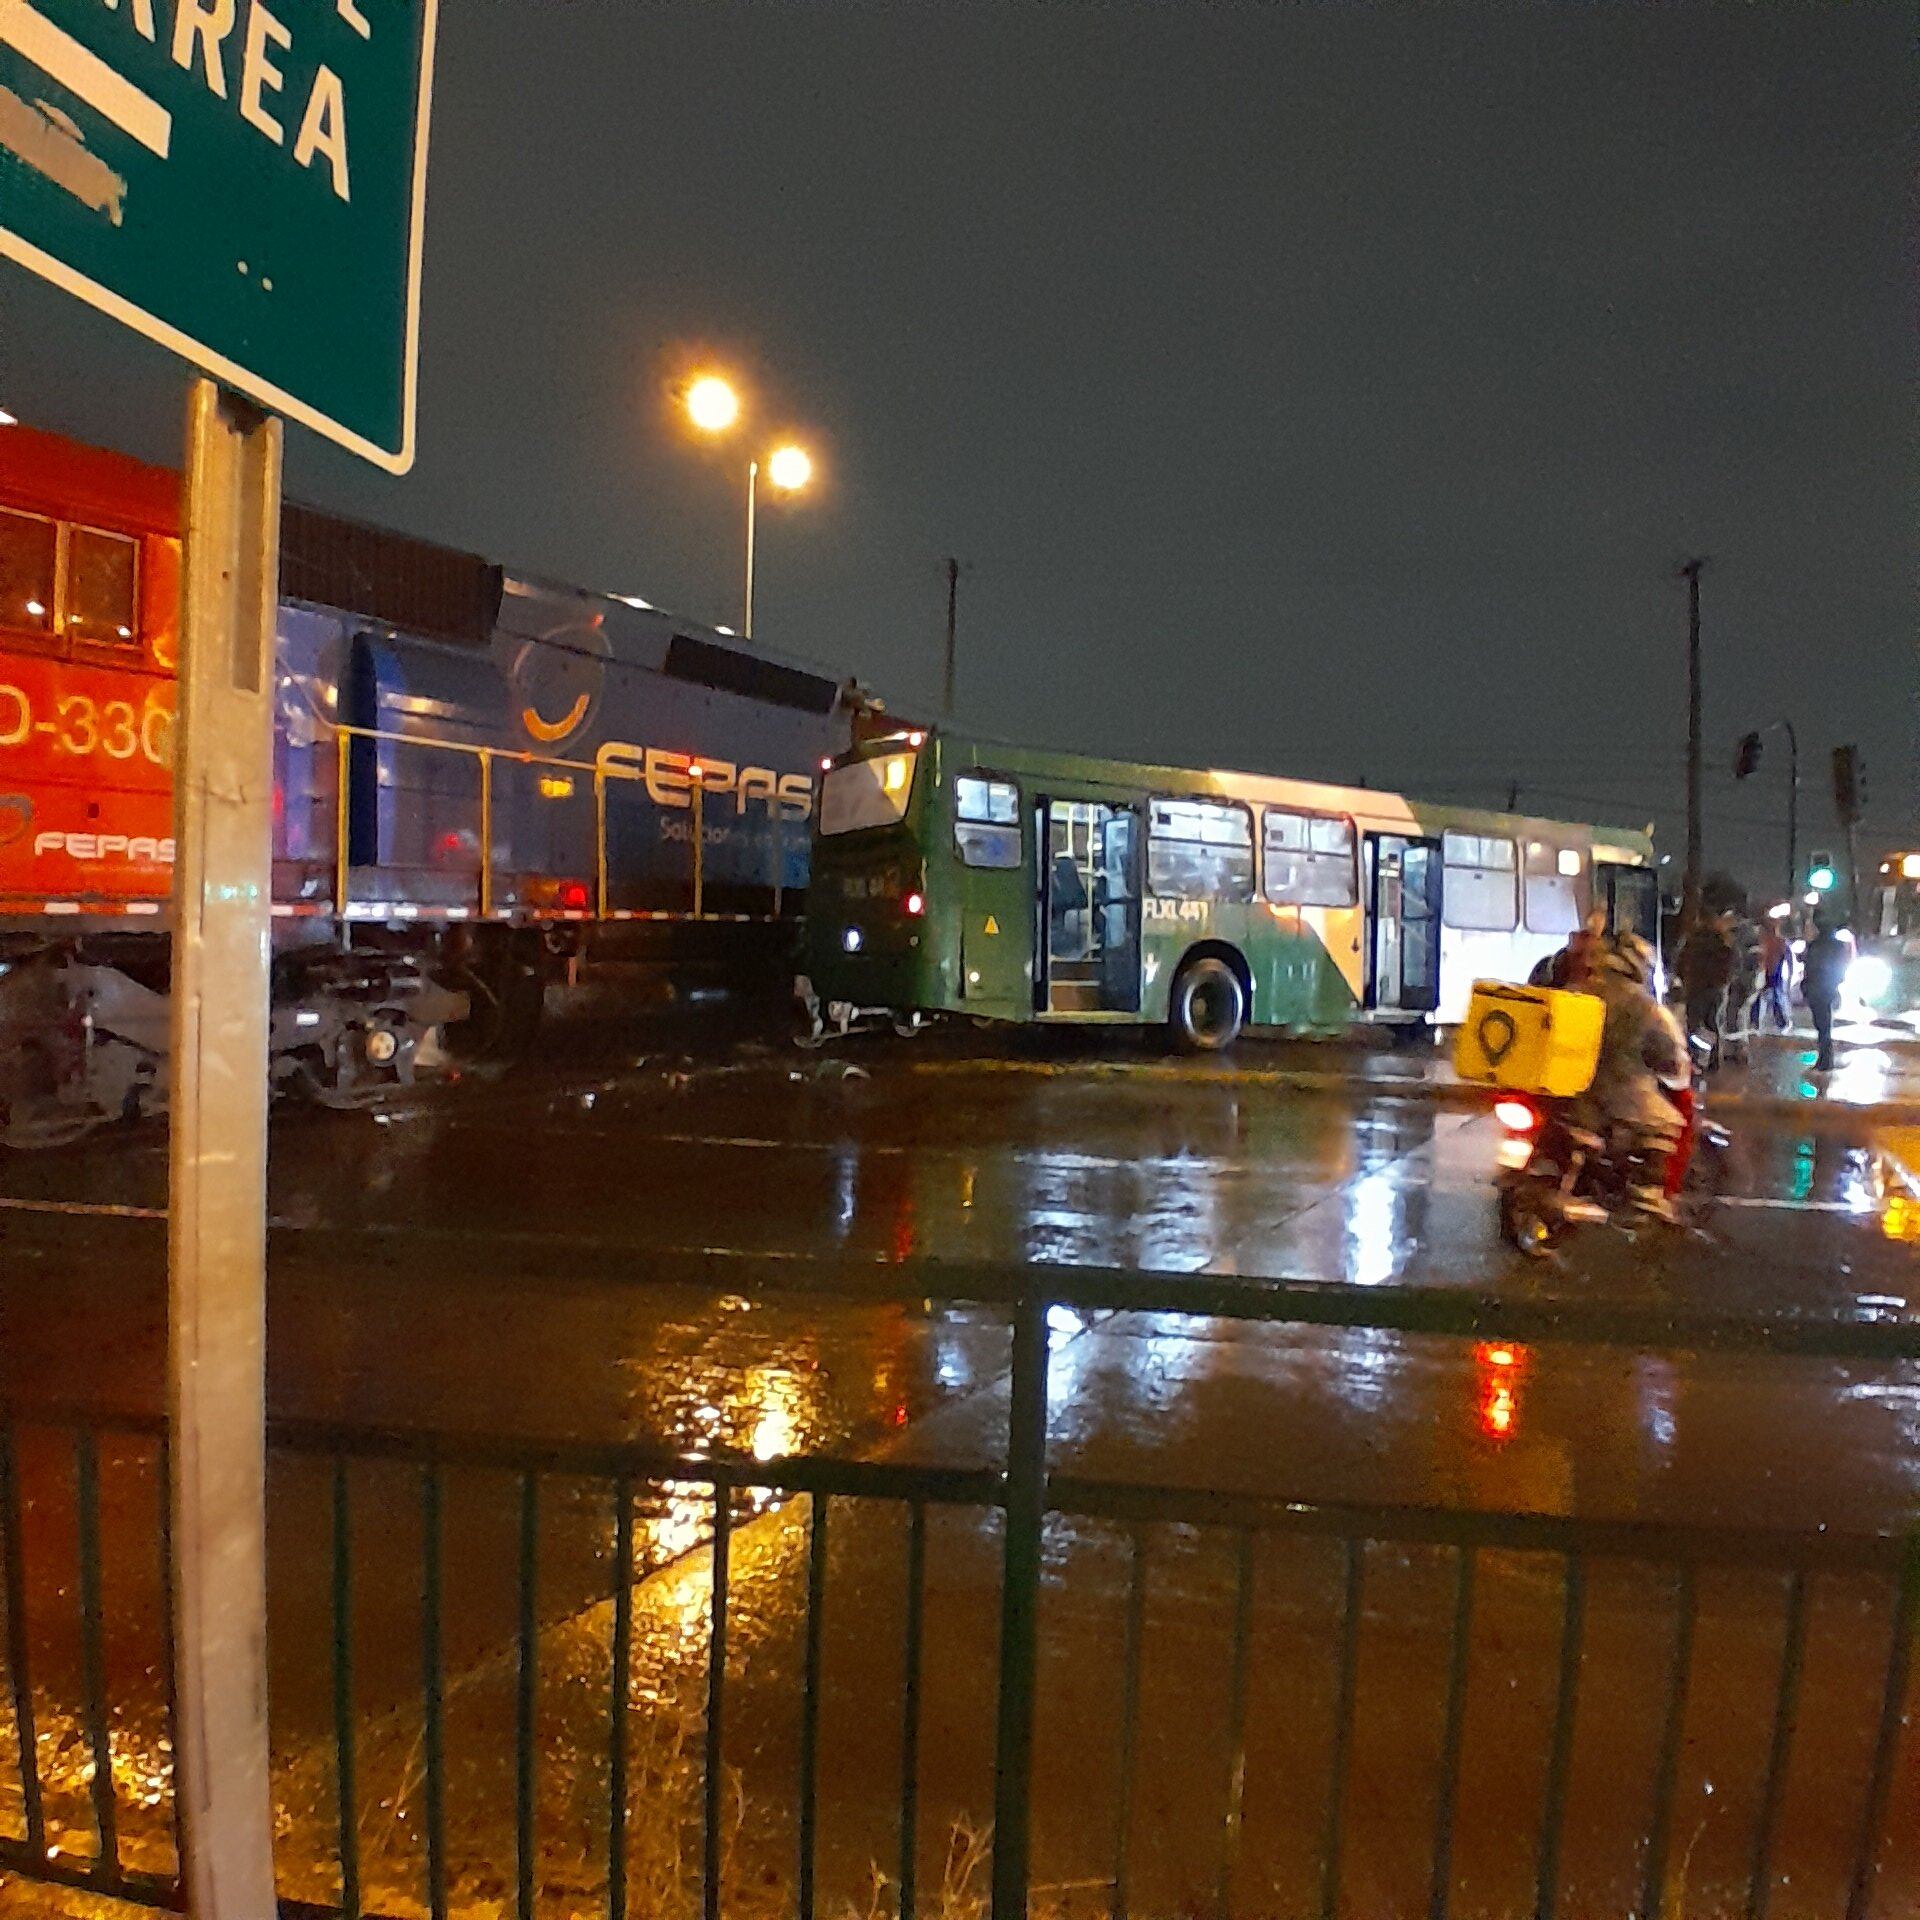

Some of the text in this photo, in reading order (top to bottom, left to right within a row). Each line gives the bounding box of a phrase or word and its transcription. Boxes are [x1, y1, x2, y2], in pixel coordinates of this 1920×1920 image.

[104, 0, 351, 203] REA
[595, 740, 812, 822] FEPAS
[35, 832, 176, 862] FEPAS
